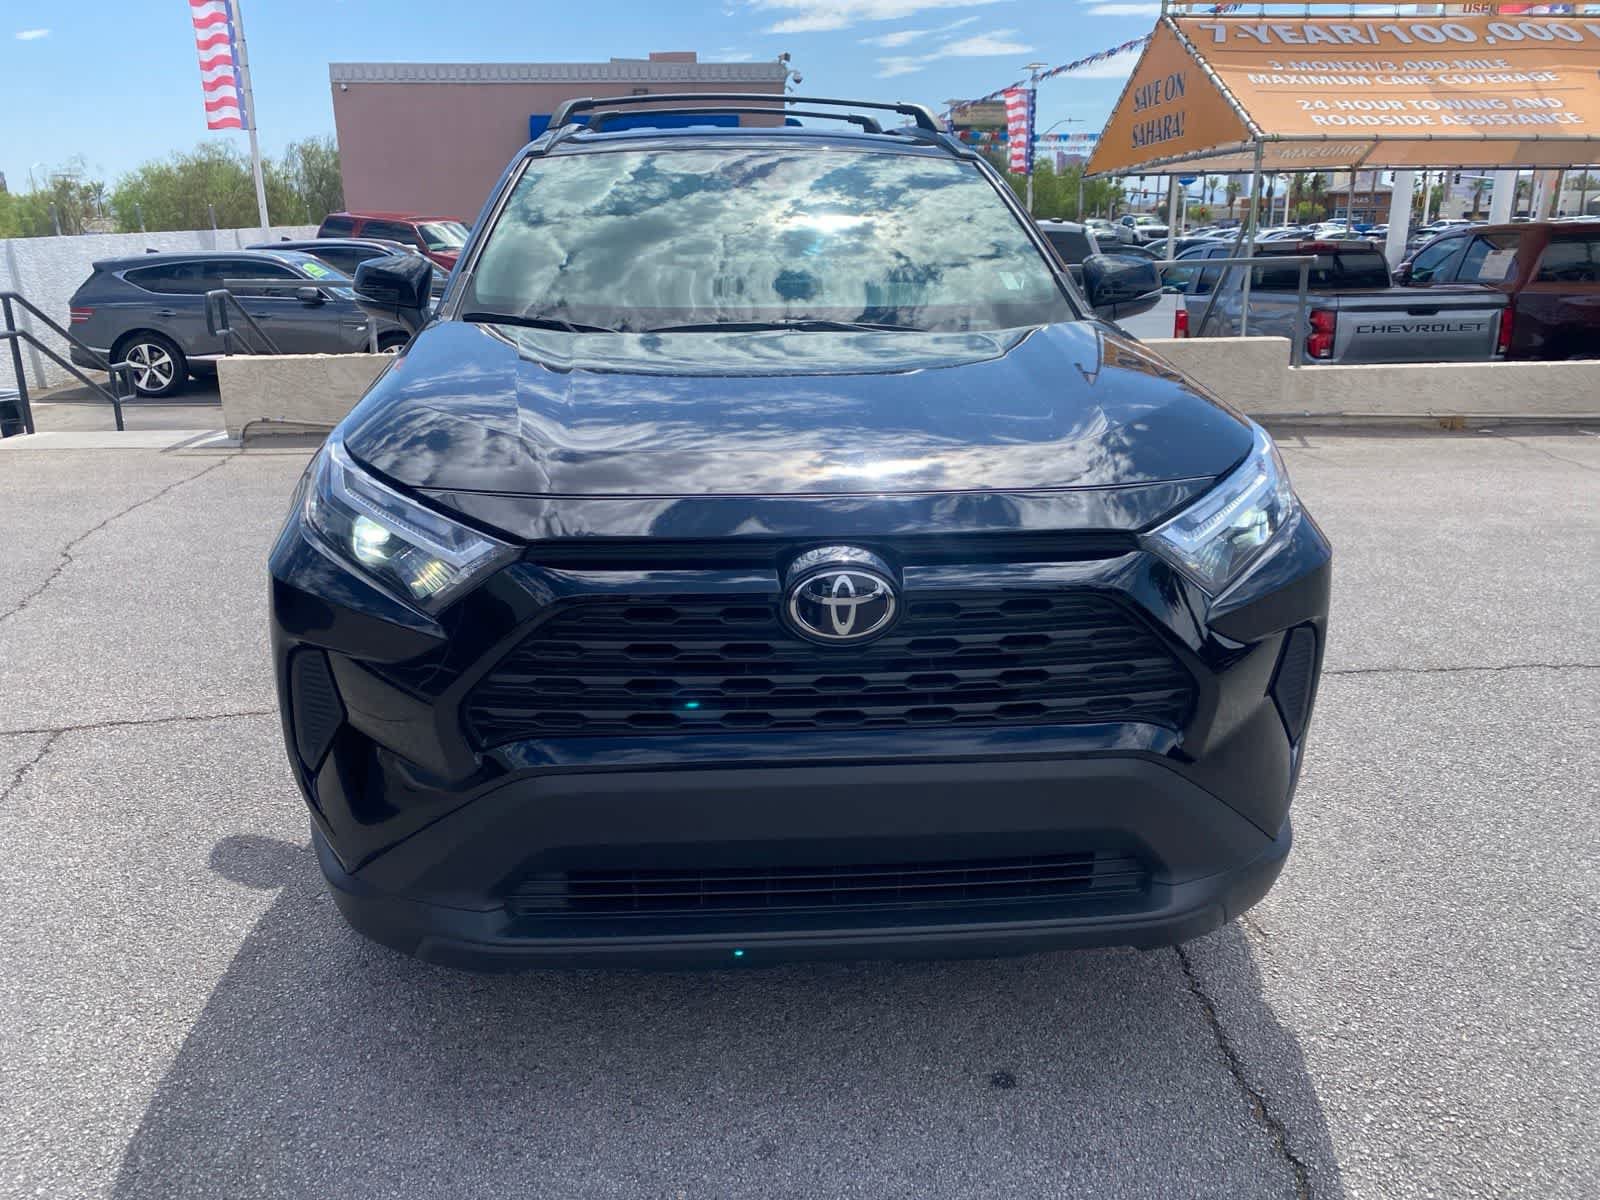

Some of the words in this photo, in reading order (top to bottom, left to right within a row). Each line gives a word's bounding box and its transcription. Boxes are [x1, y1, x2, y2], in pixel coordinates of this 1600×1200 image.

[1247, 73, 1372, 85] MAXIMUM
[1375, 73, 1436, 85] CARE
[1439, 71, 1561, 84] COVERAGE
[1133, 80, 1161, 112] SAVE
[1165, 72, 1186, 101] ON
[1296, 99, 1407, 111] 24-HOUR
[1408, 98, 1508, 111] TOWING
[1511, 96, 1564, 109] AND
[1311, 114, 1437, 126] ROADSIDE
[1440, 112, 1585, 126] ASSISTANCE
[1131, 111, 1185, 148] SAHARA!
[1356, 322, 1487, 334] CHEVROLET
